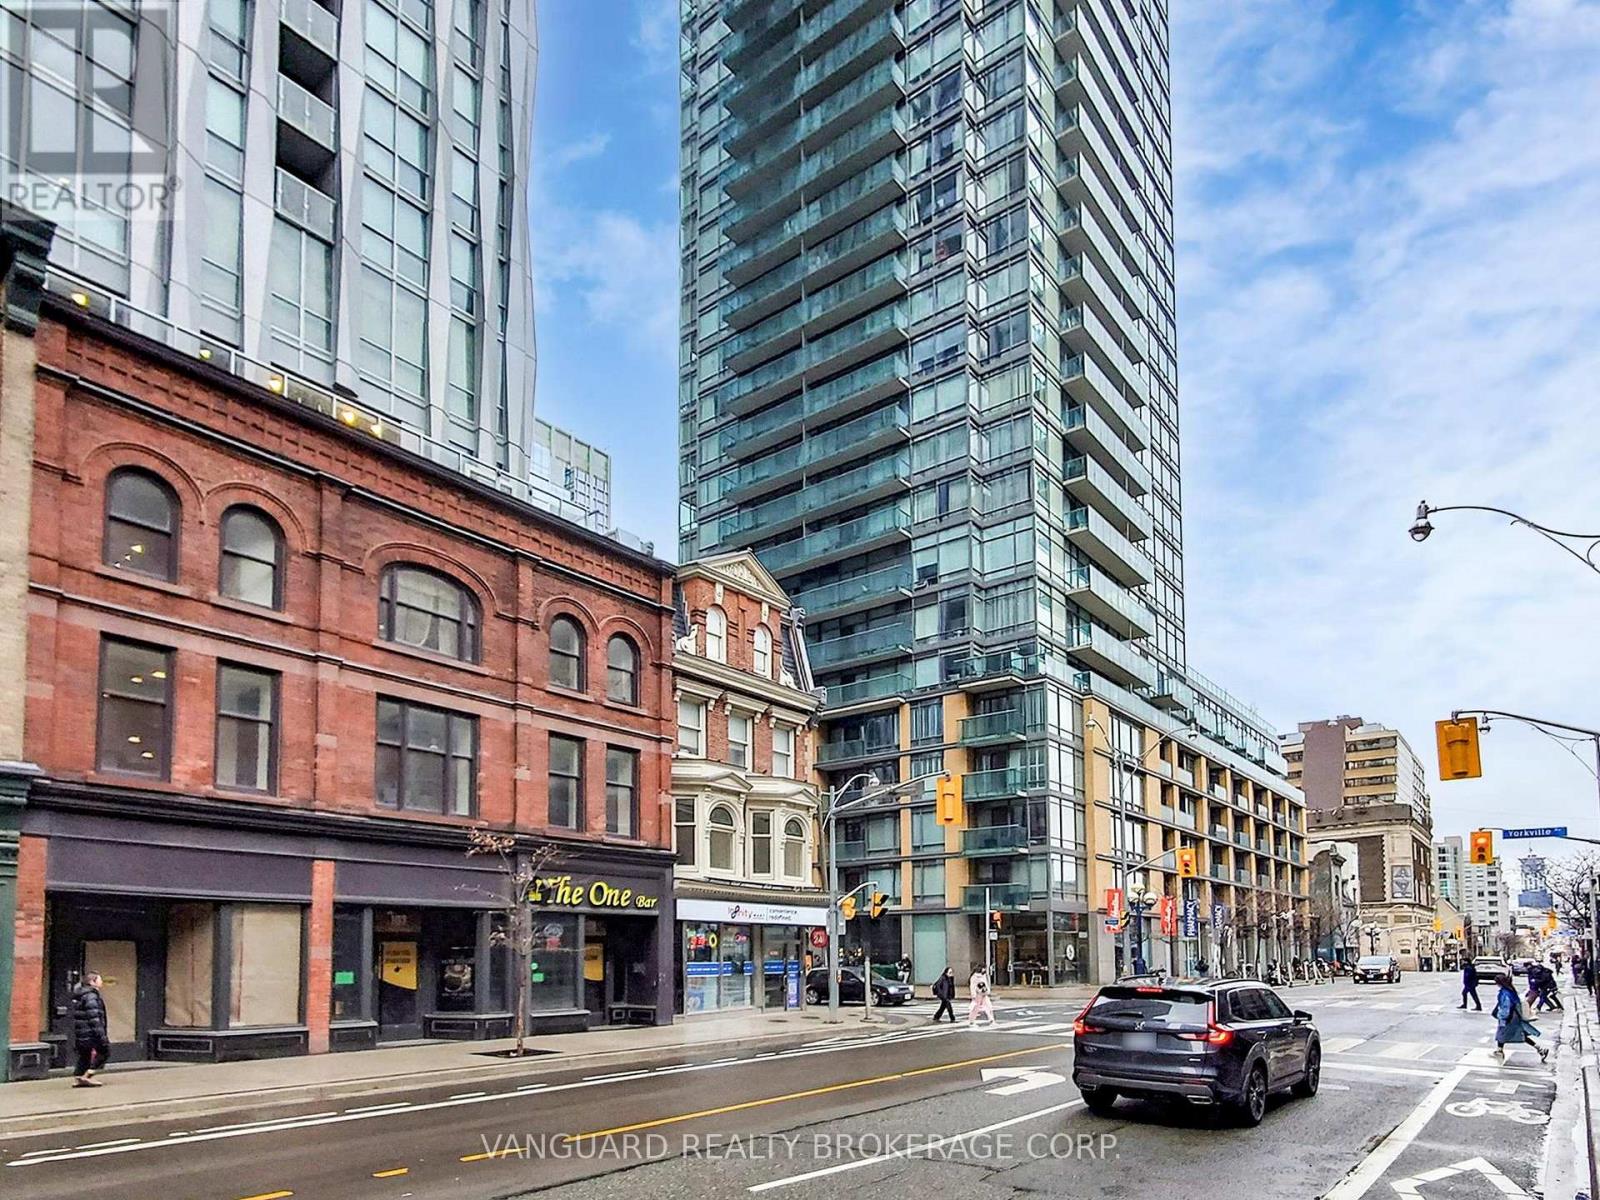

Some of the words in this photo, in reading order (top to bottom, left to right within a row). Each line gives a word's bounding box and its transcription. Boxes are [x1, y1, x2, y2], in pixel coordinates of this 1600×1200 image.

[1508, 829, 1552, 837] Yorkville
[545, 876, 585, 905] The
[589, 881, 632, 907] One
[635, 895, 658, 908] Bar
